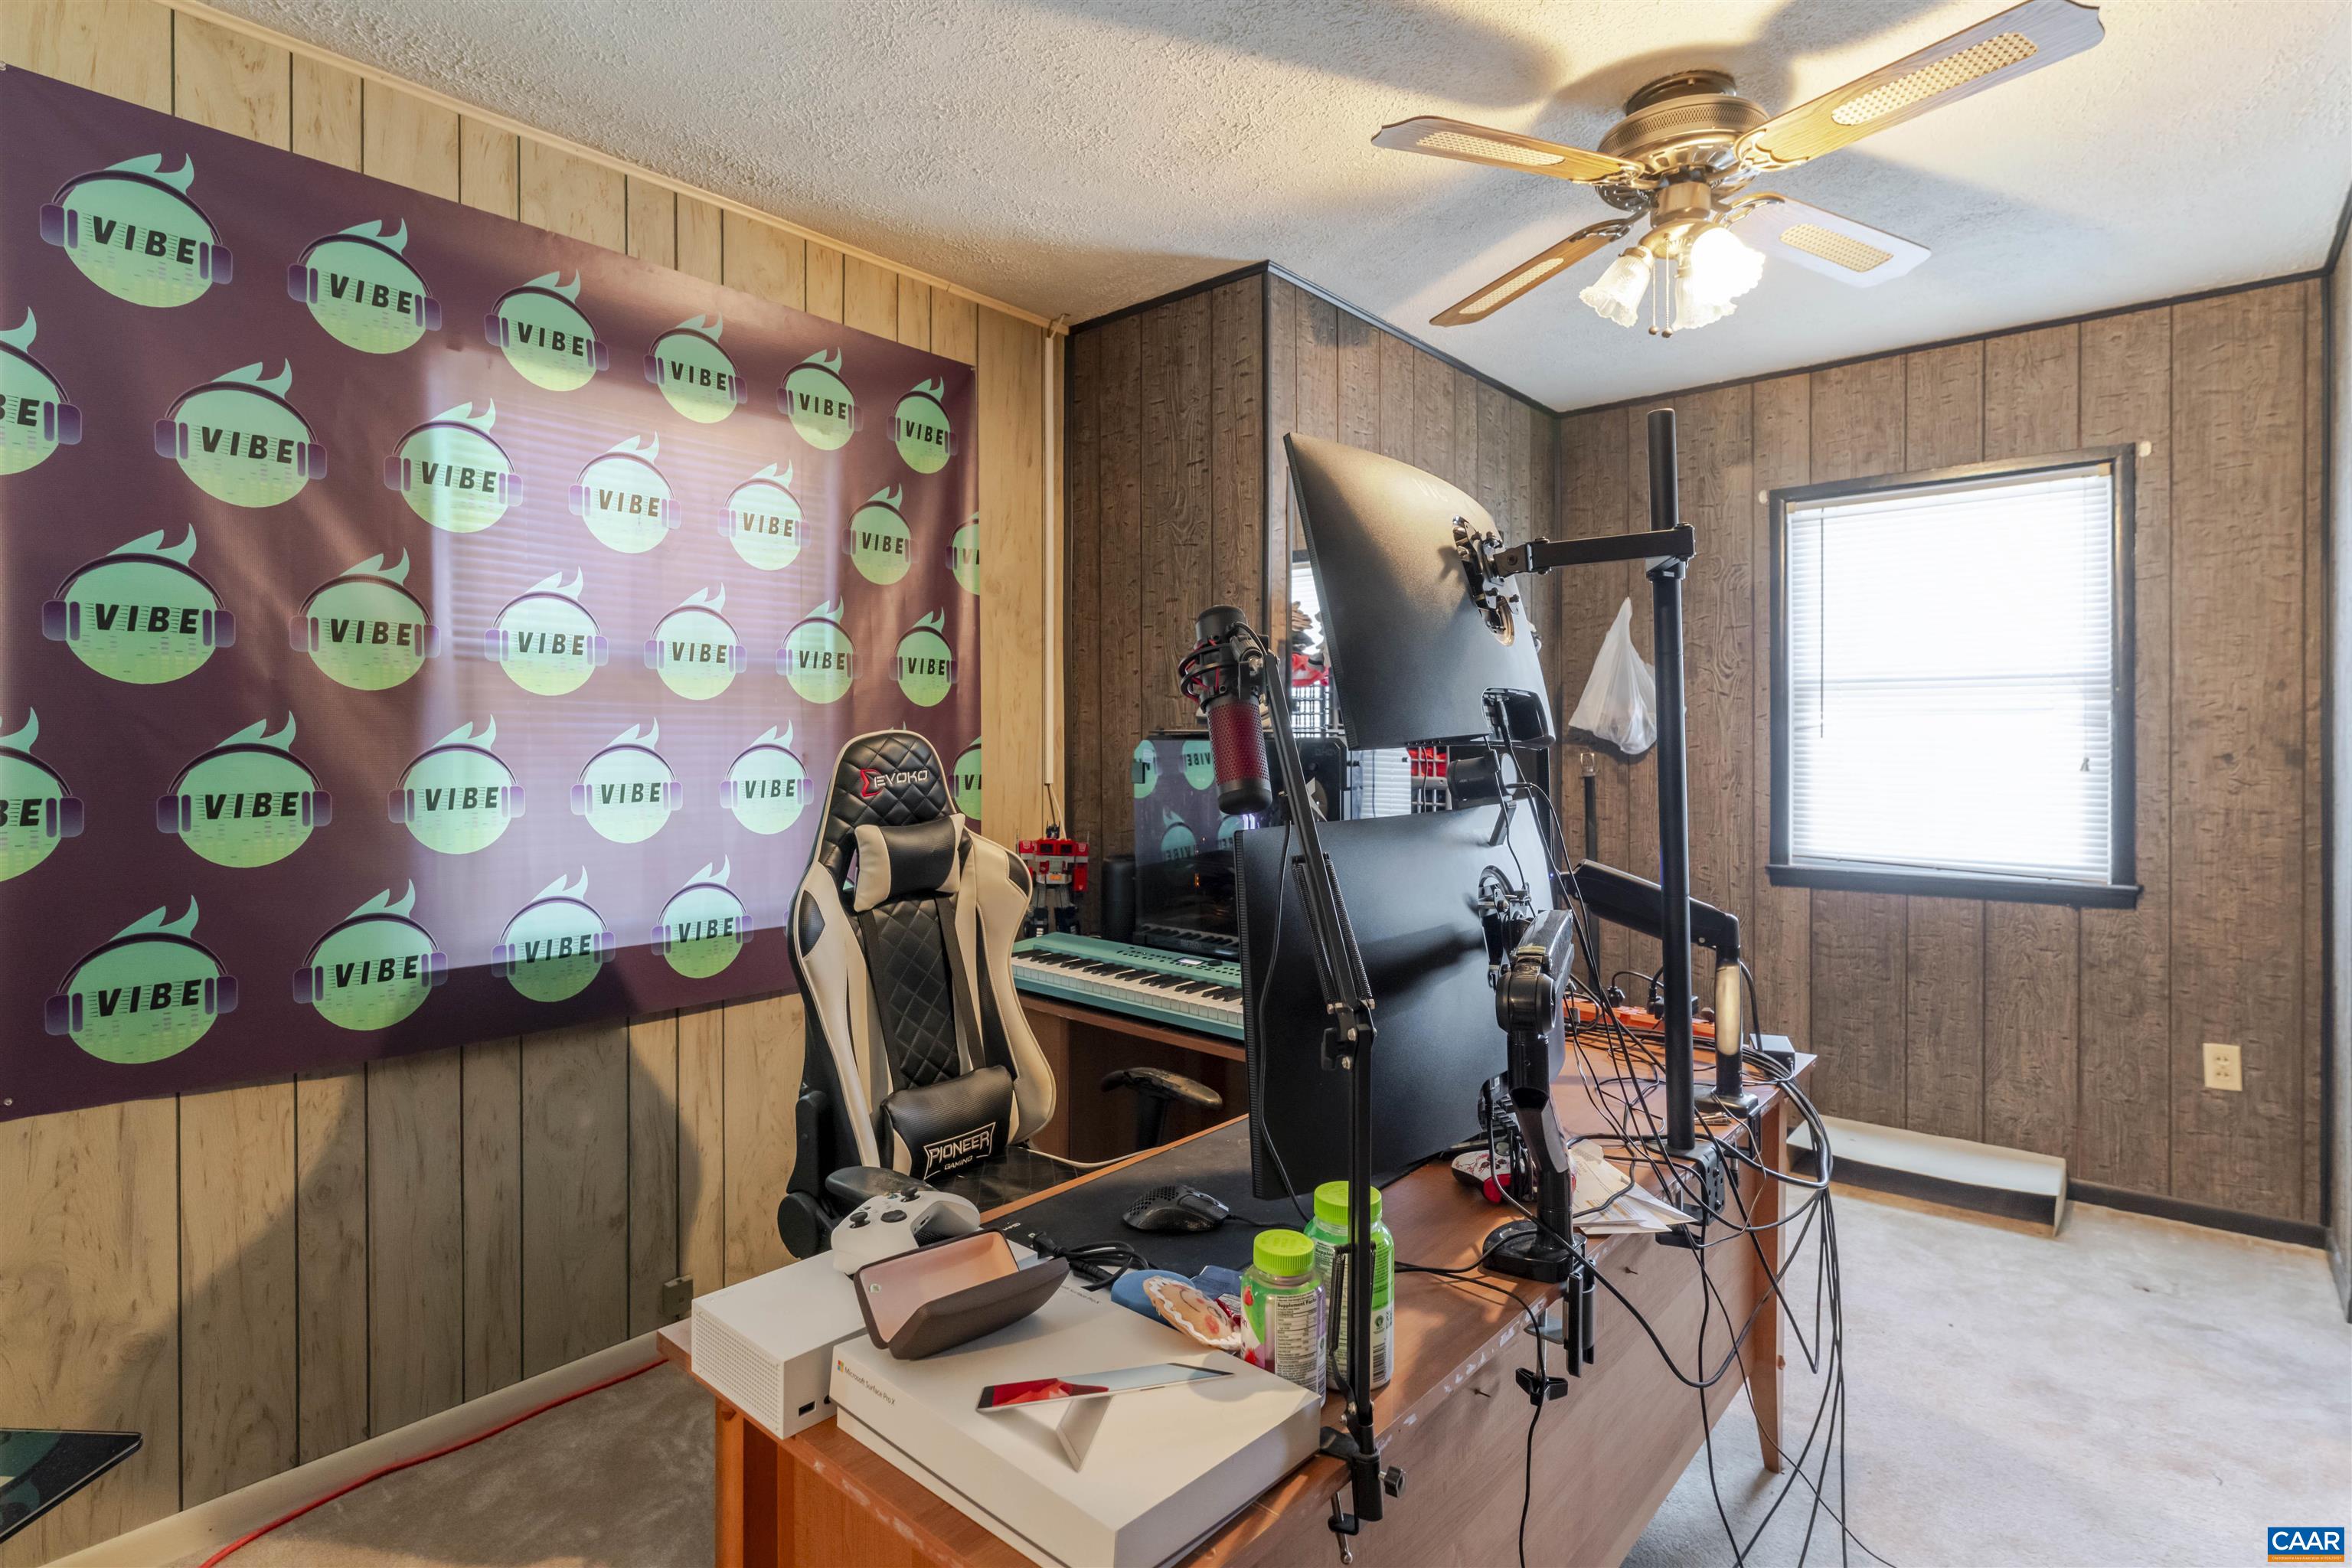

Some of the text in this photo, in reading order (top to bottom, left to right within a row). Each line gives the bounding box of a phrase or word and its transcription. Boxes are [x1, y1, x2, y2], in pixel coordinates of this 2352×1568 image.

[92, 216, 197, 265] VIBE
[329, 273, 413, 315] VIBE
[517, 322, 584, 357] VIBE
[671, 362, 727, 390] VIBE
[799, 394, 847, 420] VIBE
[201, 426, 294, 464] VIBE
[905, 420, 944, 446] VIBE
[420, 462, 496, 492] VIBE
[599, 489, 659, 517] VIBE
[743, 512, 793, 537] VIBE
[861, 532, 903, 555] VIBE
[94, 603, 199, 635] VIBE
[330, 619, 413, 646] VIBE
[518, 632, 585, 655] VIBE
[672, 642, 727, 664] VIBE
[799, 651, 845, 671] VIBE
[907, 658, 945, 677] VIBE
[424, 786, 499, 812] VIBE
[600, 782, 661, 804] VIBE
[745, 779, 795, 799] VIBE
[204, 792, 299, 820] VIBE
[678, 917, 734, 943] VIBE
[524, 933, 592, 964] VIBE
[335, 955, 420, 988] VIBE
[97, 978, 202, 1017] VIBE
[929, 1130, 990, 1168] PIONEER
[944, 1155, 973, 1170] GAMING
[844, 1367, 865, 1386] Microsoft
[865, 1380, 883, 1397] Surface
[883, 1392, 891, 1403] Pro
